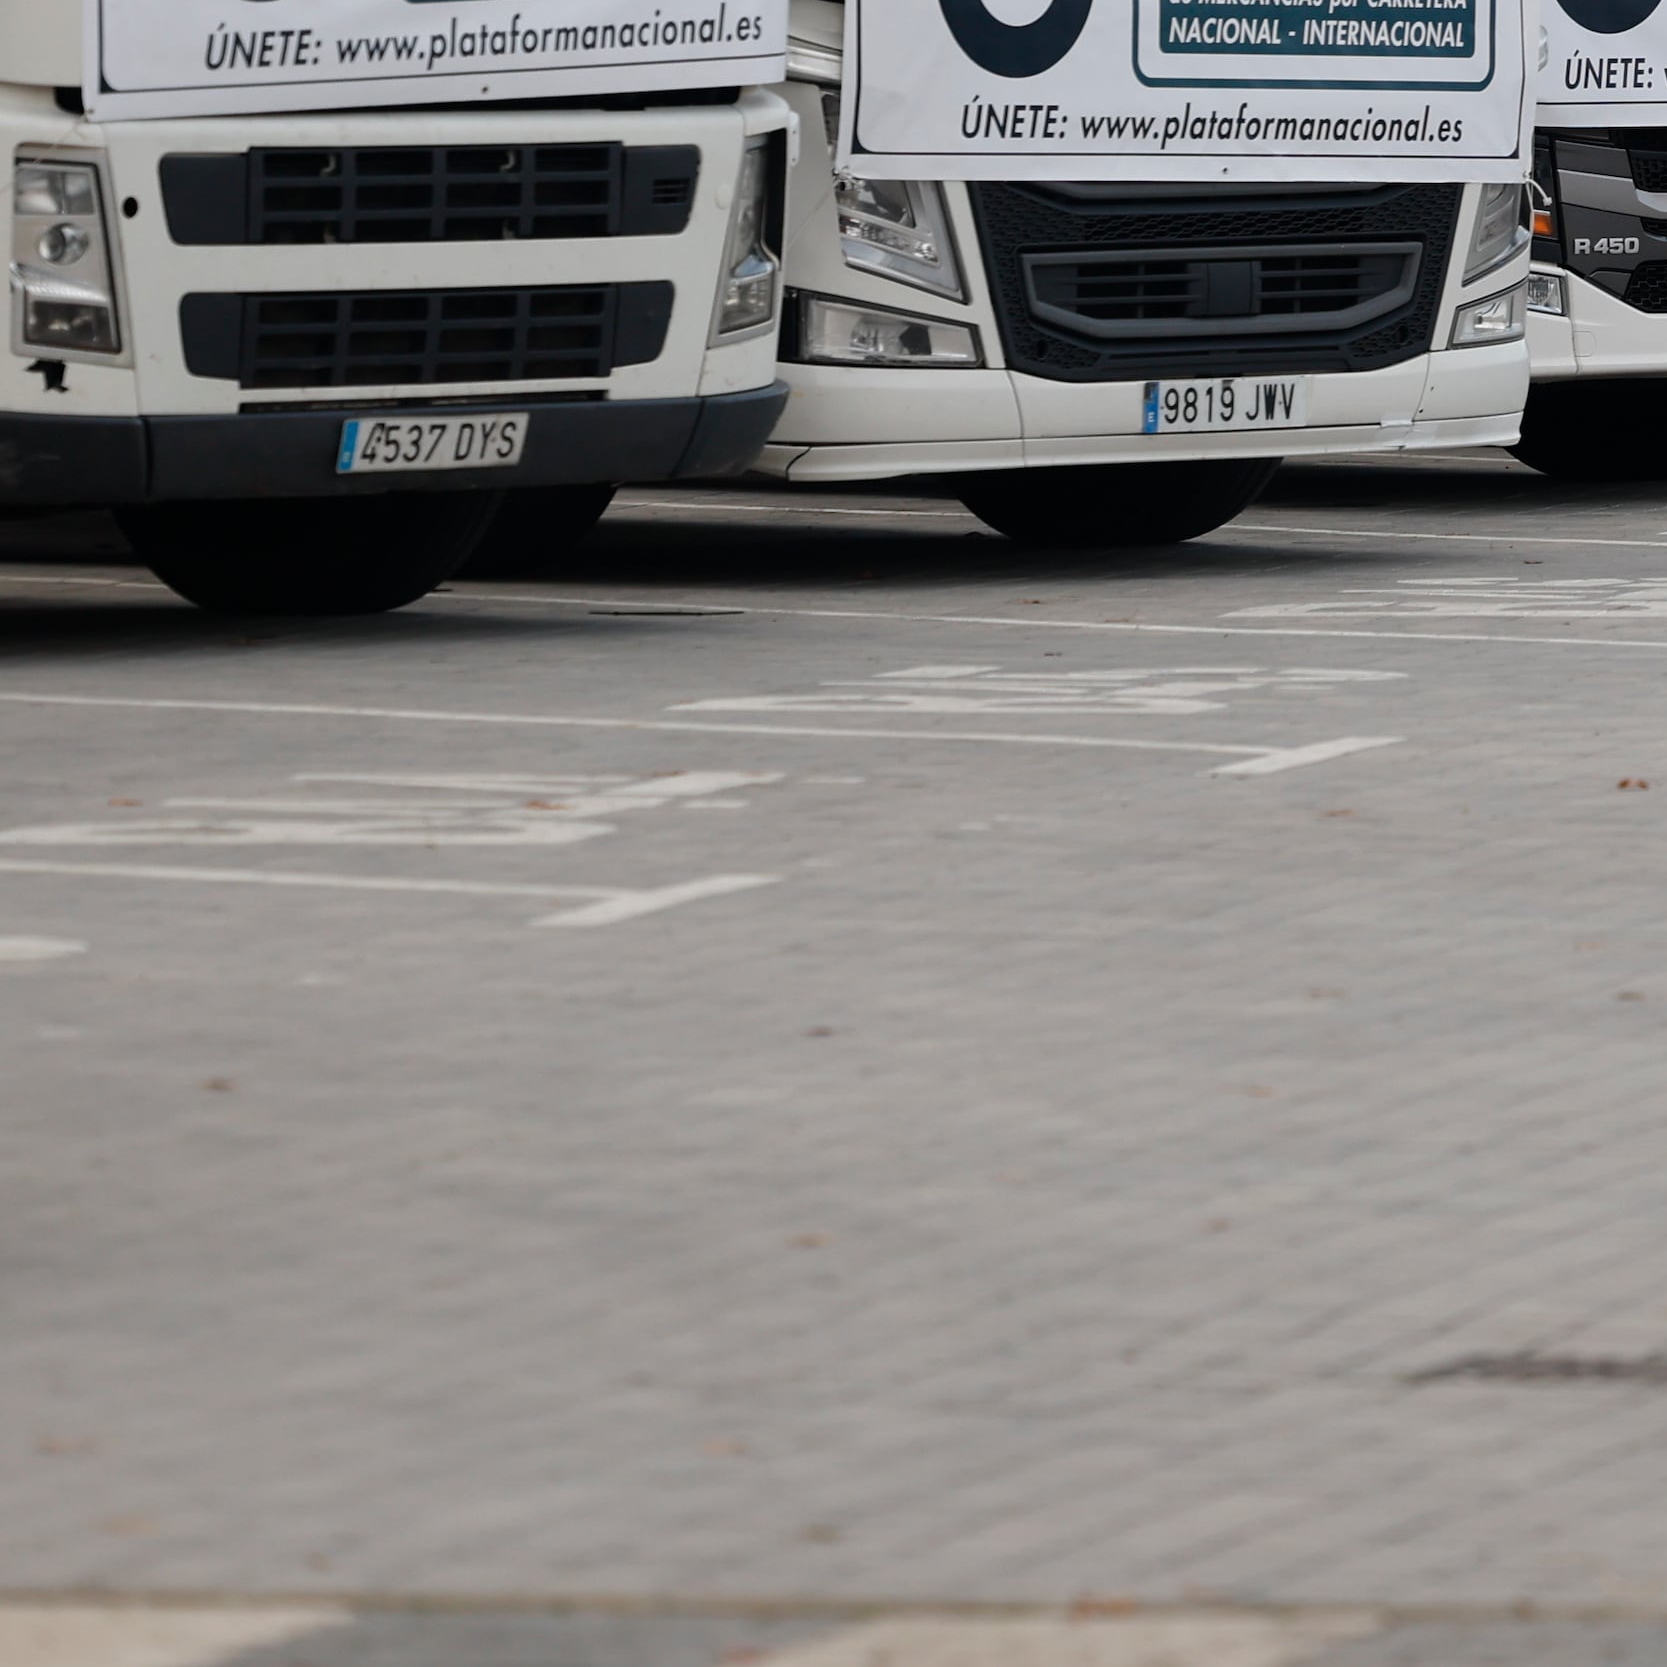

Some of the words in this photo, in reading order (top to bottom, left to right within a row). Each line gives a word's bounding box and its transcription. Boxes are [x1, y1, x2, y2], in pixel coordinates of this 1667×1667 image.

[204, 22, 322, 71] ÚNETE:
[335, 4, 762, 71] www.plataformanacional.es
[1168, 17, 1282, 44] NACIONAL
[1303, 20, 1464, 48] INTERNACIONAL
[1565, 51, 1653, 90] ÚNETE:
[961, 95, 1068, 139] ÚNETE:
[1081, 102, 1463, 150] www.plataformanacional.es
[1575, 238, 1591, 255] R
[1594, 237, 1640, 254] 450
[1164, 387, 1235, 424] 9819
[1246, 383, 1295, 421] JWV
[360, 422, 447, 464] 4537
[454, 421, 516, 461] DYS
